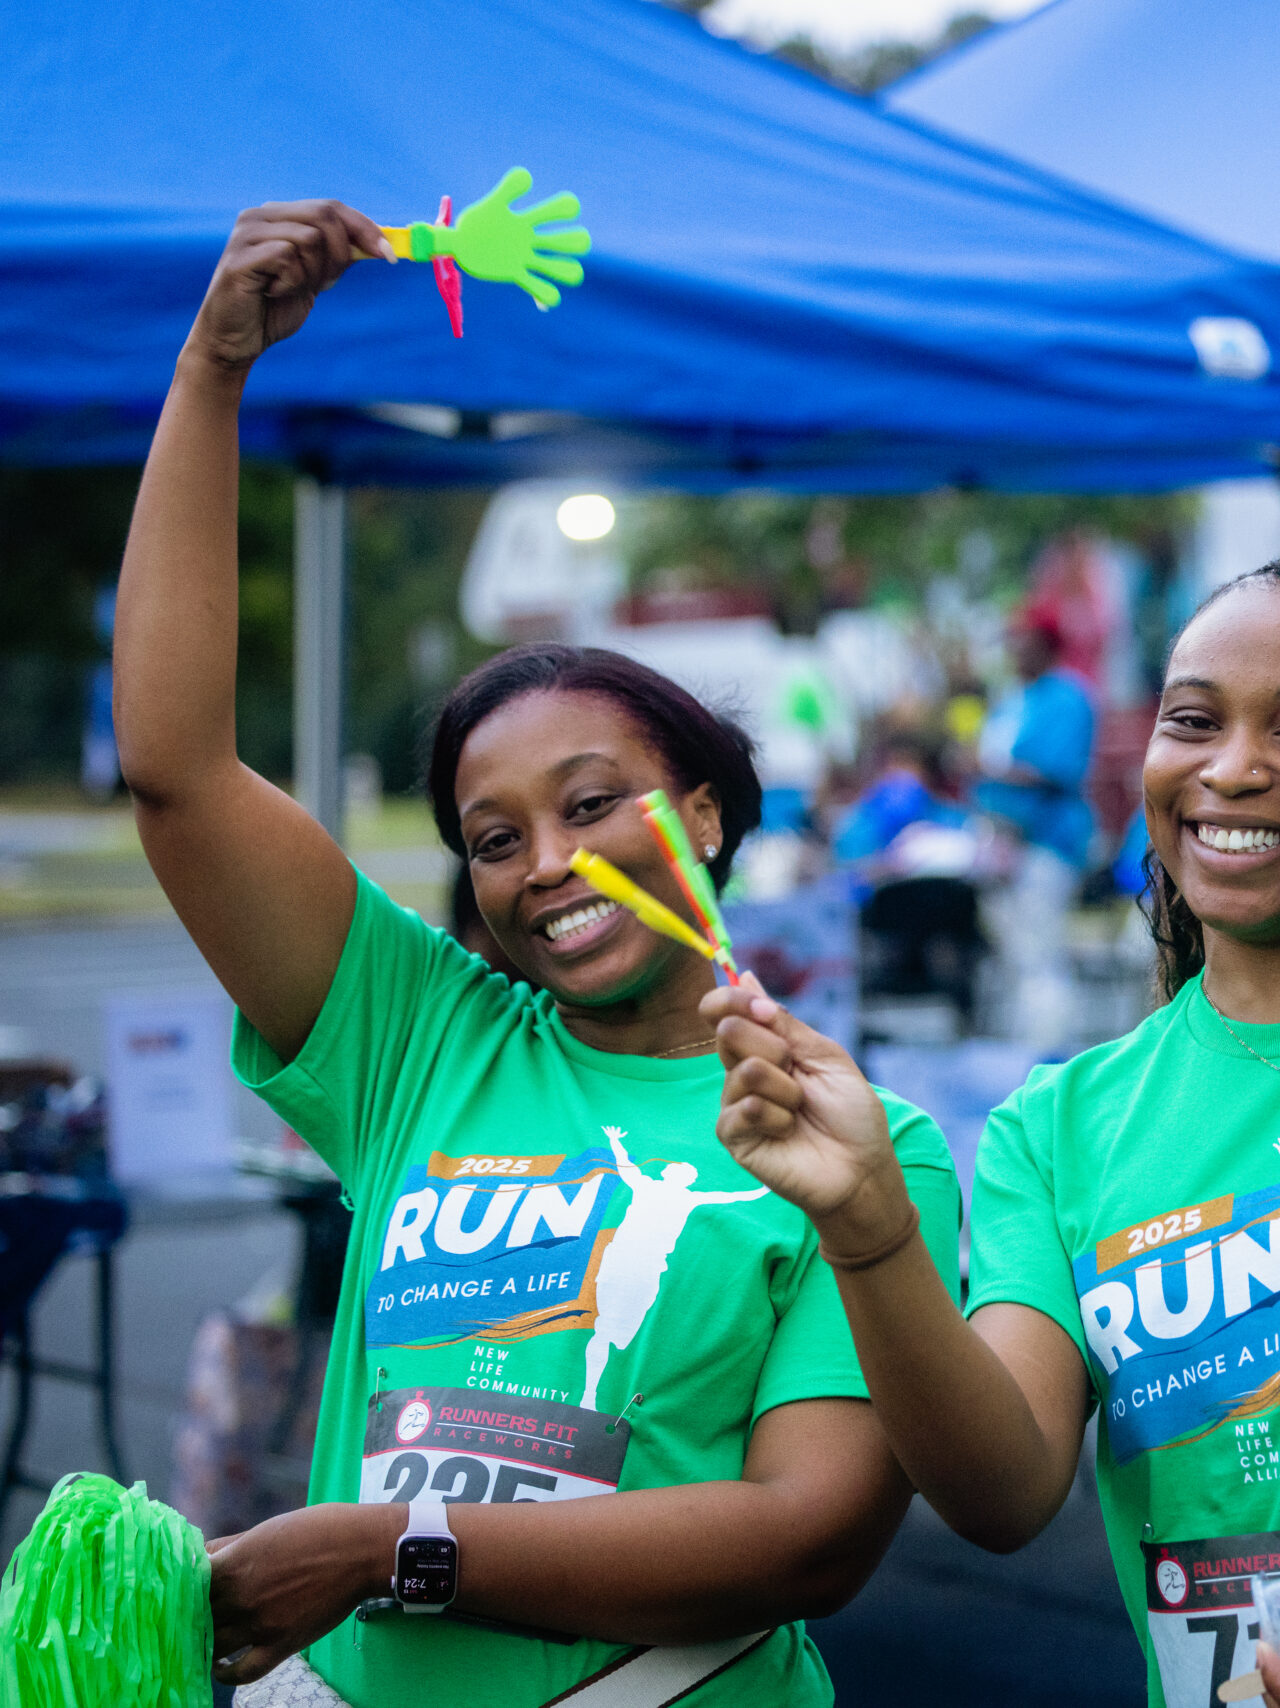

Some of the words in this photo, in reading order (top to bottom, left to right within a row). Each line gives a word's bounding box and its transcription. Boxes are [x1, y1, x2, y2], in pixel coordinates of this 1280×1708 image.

[454, 1157, 533, 1176] 2025
[380, 1173, 605, 1271] RUN
[1127, 1208, 1202, 1253] 2025
[376, 1293, 394, 1313] TO
[400, 1279, 492, 1307] CHANGE
[501, 1277, 518, 1295] A
[526, 1271, 571, 1292] LIFE
[474, 1345, 509, 1360] NEW
[470, 1361, 503, 1376] LIFE
[1112, 1398, 1126, 1421] TO
[1131, 1355, 1227, 1408] CHANGE
[1238, 1345, 1255, 1367] A
[466, 1376, 569, 1402] COMMUNITY
[438, 1406, 539, 1433] RUNNERS
[543, 1422, 579, 1441] FIT
[1235, 1421, 1269, 1437] NEW
[433, 1427, 573, 1459] RACEWORKS
[1237, 1437, 1273, 1452] LIFE
[404, 1578, 426, 1589] 7:24
[1186, 1613, 1259, 1708] 7
